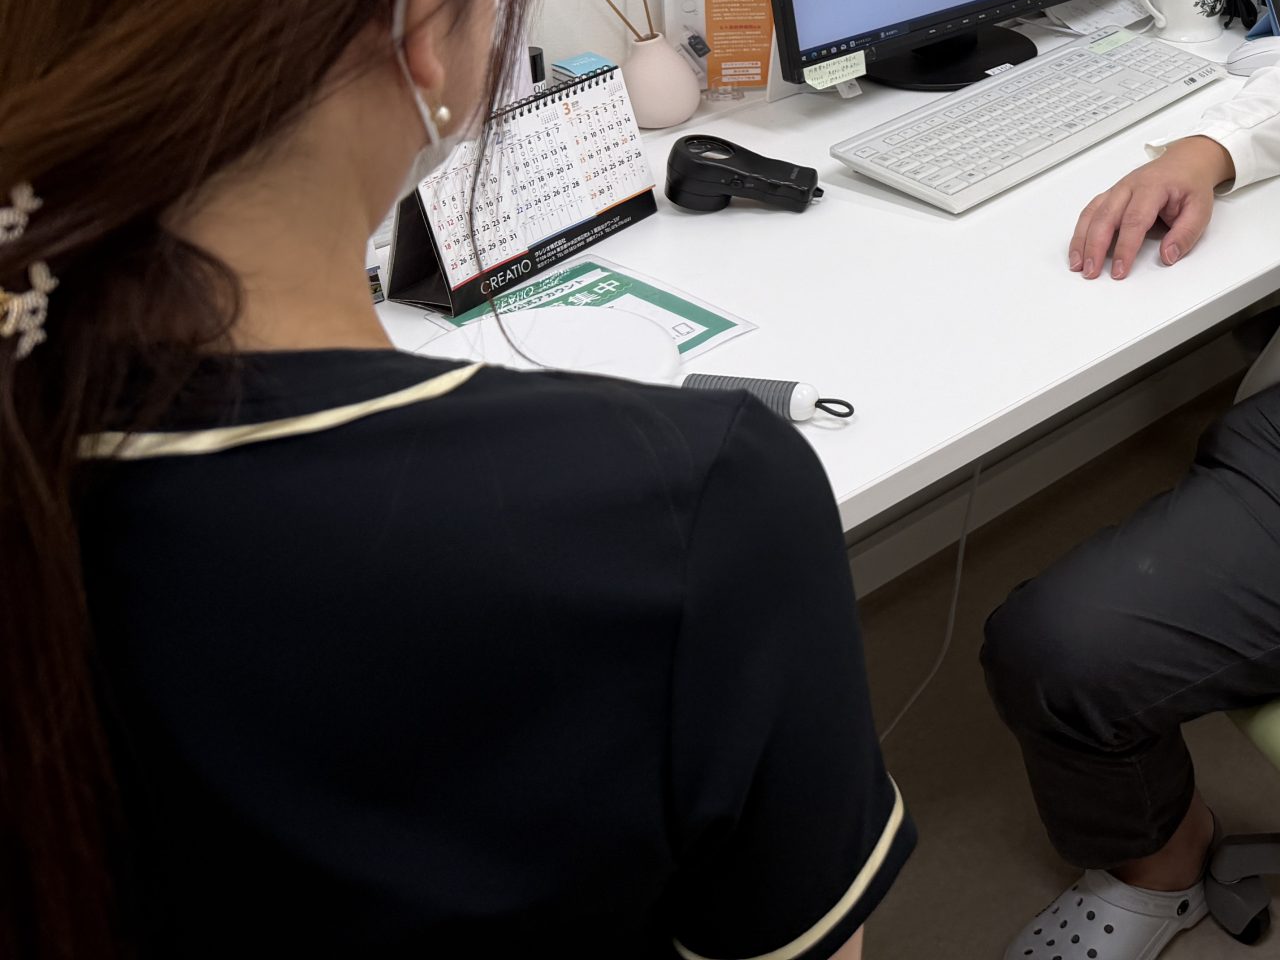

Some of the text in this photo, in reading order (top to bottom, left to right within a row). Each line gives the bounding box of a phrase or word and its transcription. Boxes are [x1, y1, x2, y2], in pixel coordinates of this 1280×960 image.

[563, 102, 571, 115] 3
[556, 167, 564, 175] 20
[486, 200, 493, 208] 16
[463, 233, 470, 241] 20
[482, 224, 490, 232] 22
[492, 219, 500, 227] 23
[503, 214, 511, 222] 24
[451, 262, 458, 270] 25
[460, 257, 467, 265] 26
[479, 248, 486, 256] 28
[510, 233, 517, 241] 31
[480, 260, 532, 294] CREATIO
